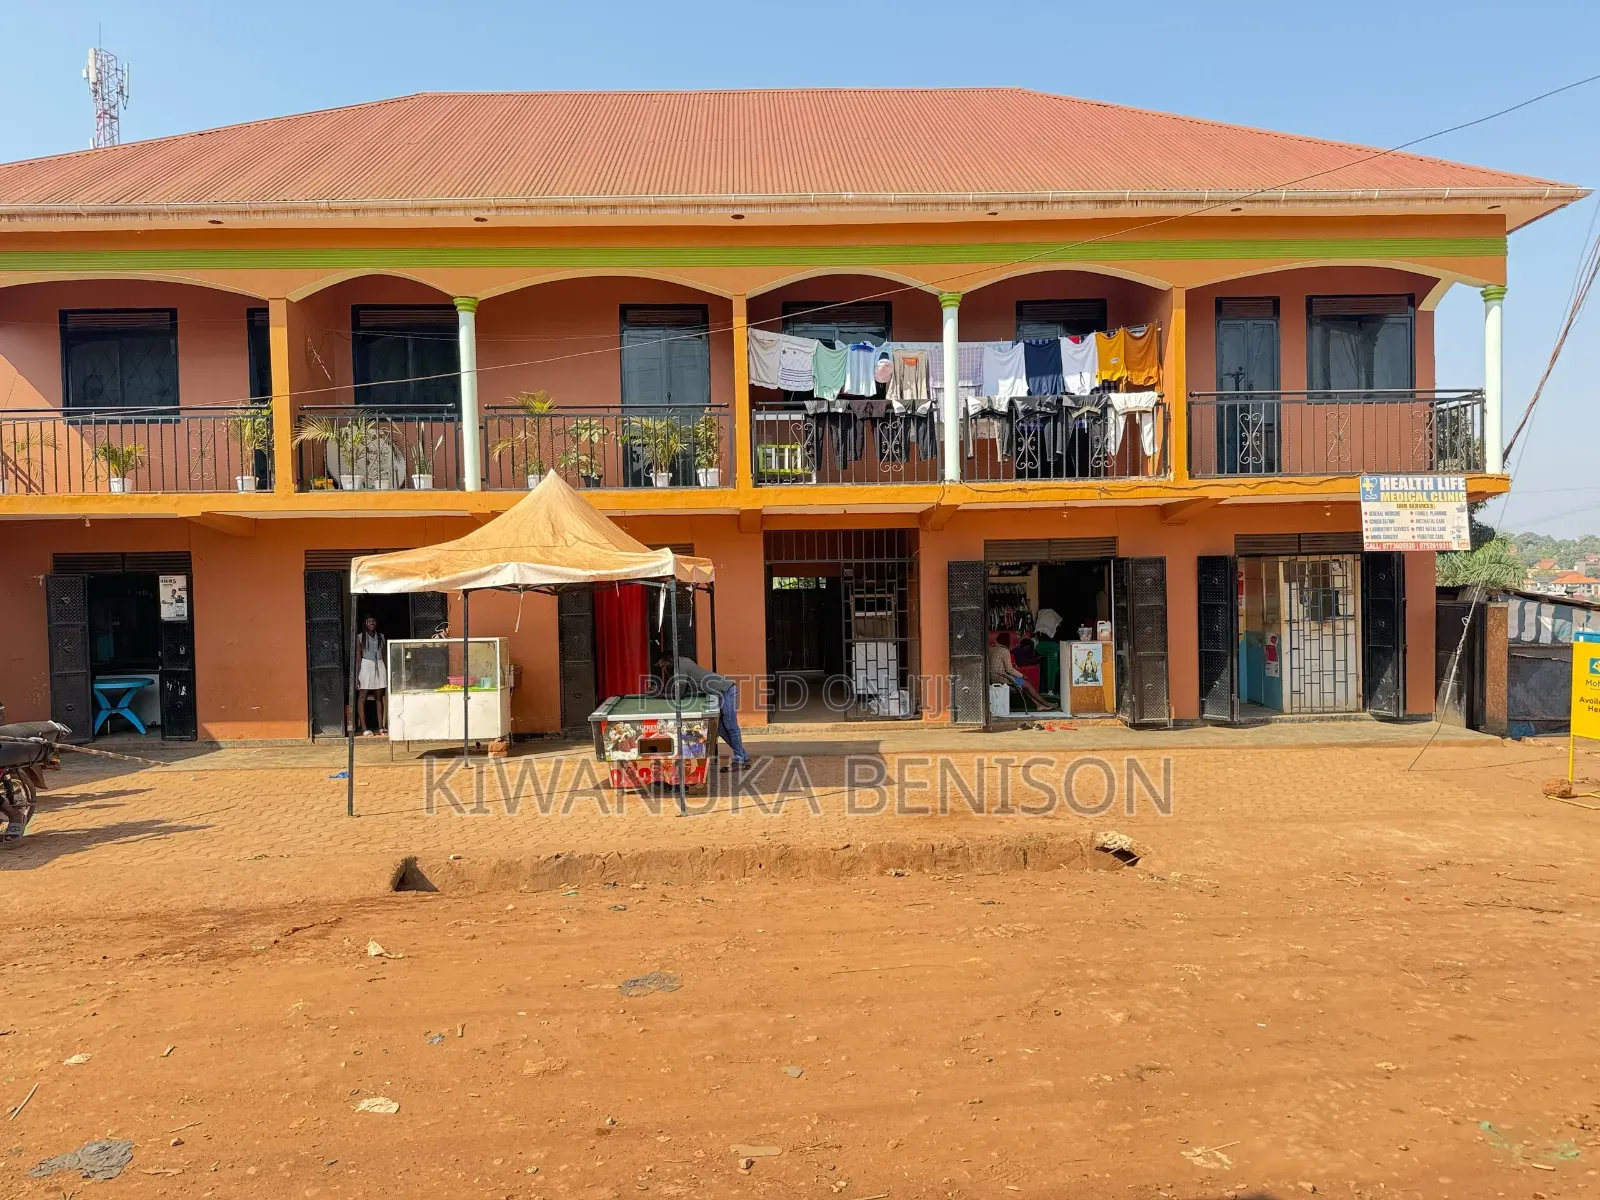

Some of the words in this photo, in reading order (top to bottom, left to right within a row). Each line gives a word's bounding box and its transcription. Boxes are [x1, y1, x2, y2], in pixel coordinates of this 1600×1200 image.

[1380, 477, 1434, 490] HEALTH
[1437, 477, 1466, 490] LIFE
[1380, 491, 1429, 502] MEDICAL
[1430, 491, 1467, 502] CLINIC
